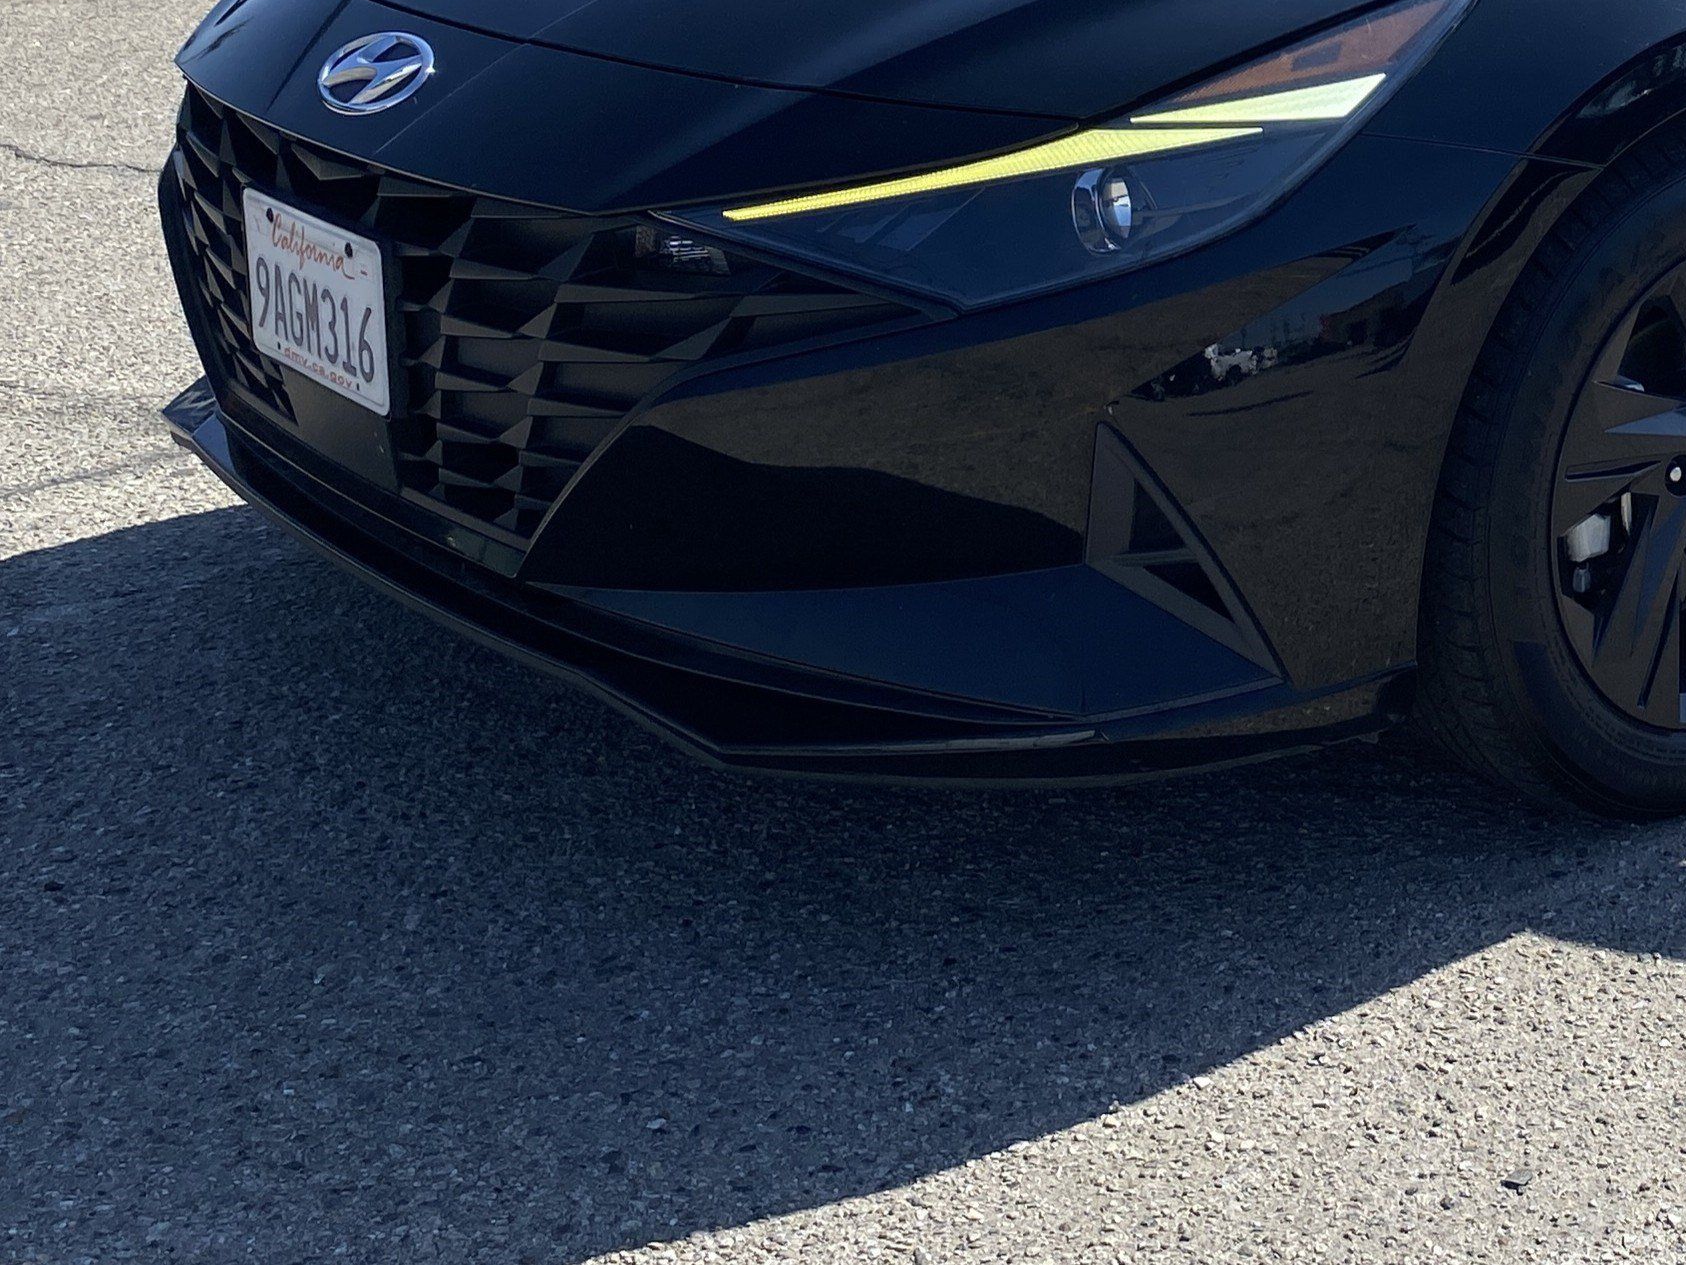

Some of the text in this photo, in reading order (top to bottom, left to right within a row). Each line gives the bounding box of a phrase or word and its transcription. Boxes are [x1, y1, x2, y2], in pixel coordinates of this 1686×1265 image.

[271, 213, 355, 280] California
[256, 257, 375, 383] 9AGM316
[284, 346, 352, 388] dmv.ca.gov
